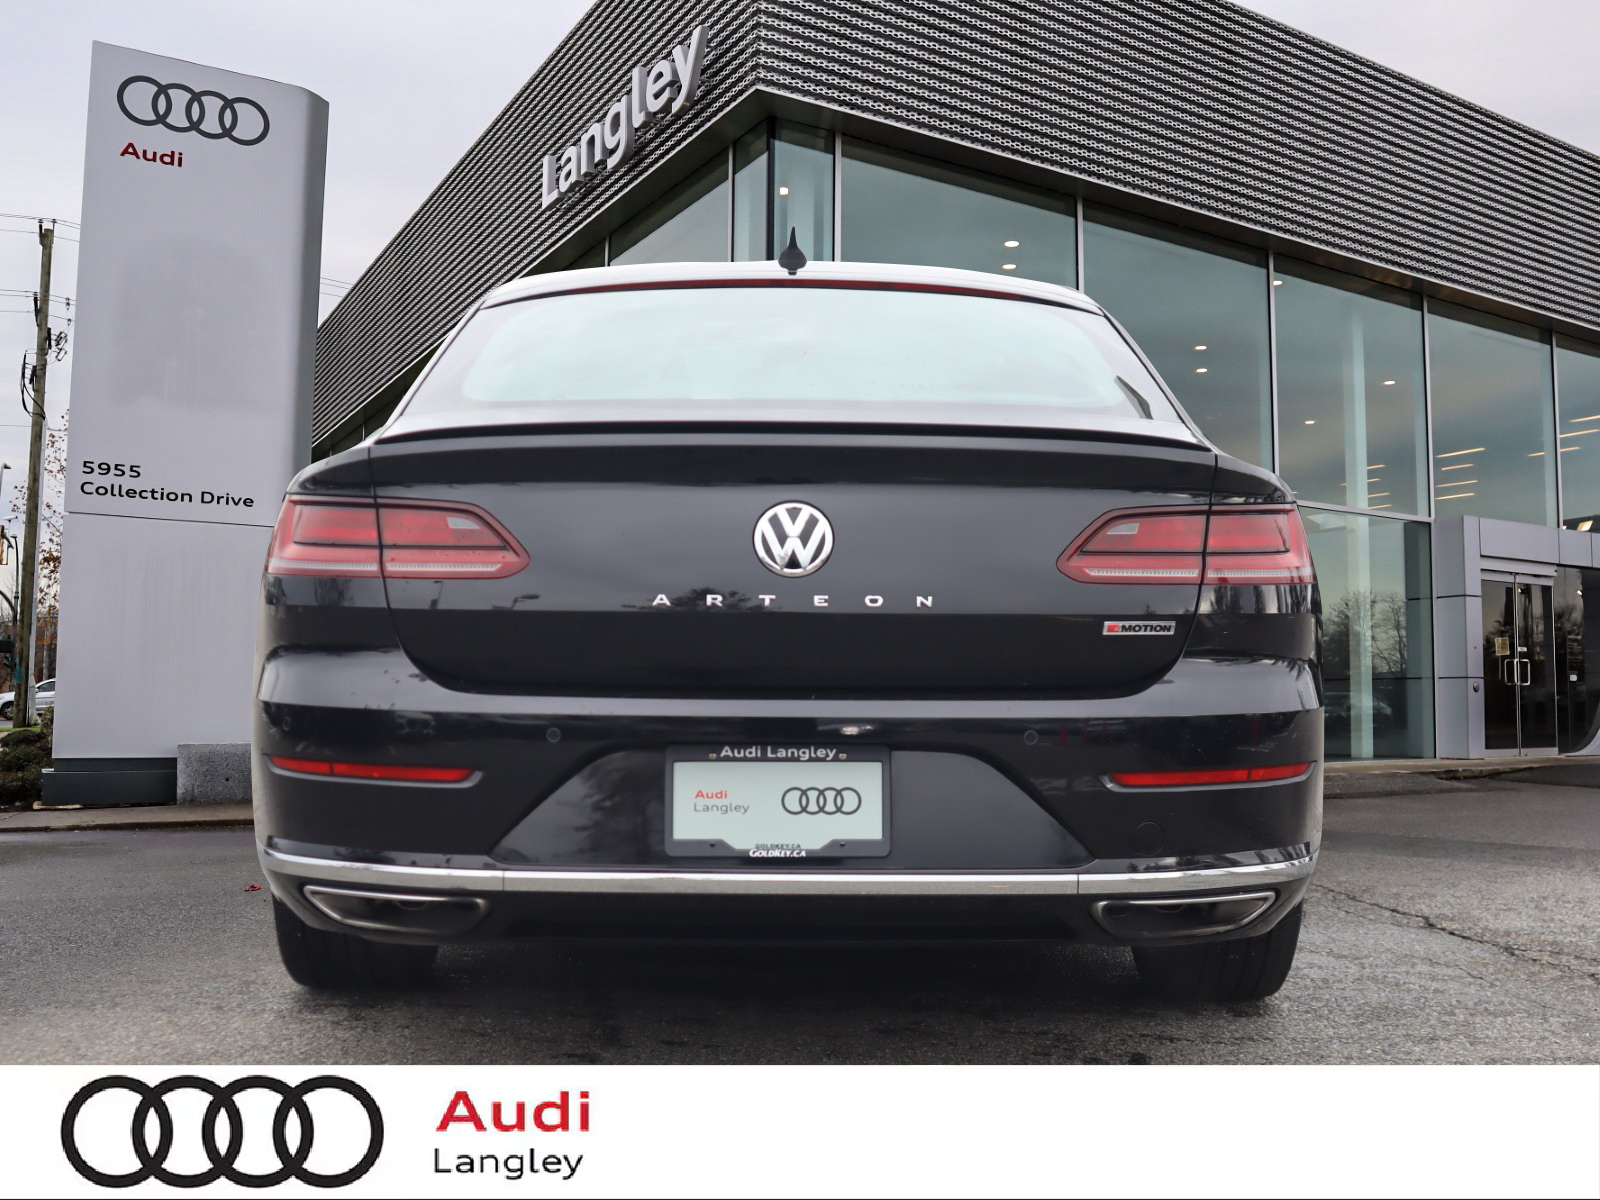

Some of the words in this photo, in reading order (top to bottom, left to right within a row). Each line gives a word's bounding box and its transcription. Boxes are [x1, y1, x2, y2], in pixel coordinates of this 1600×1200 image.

[542, 25, 709, 209] Langley
[119, 142, 183, 168] Audi
[82, 460, 141, 478] 5955
[80, 481, 193, 503] Collection
[200, 491, 255, 508] Drive
[652, 593, 933, 608] ARTEON
[720, 745, 761, 758] Audi
[767, 745, 837, 760] Langley
[694, 789, 728, 799] Audi
[693, 802, 750, 815] Langley
